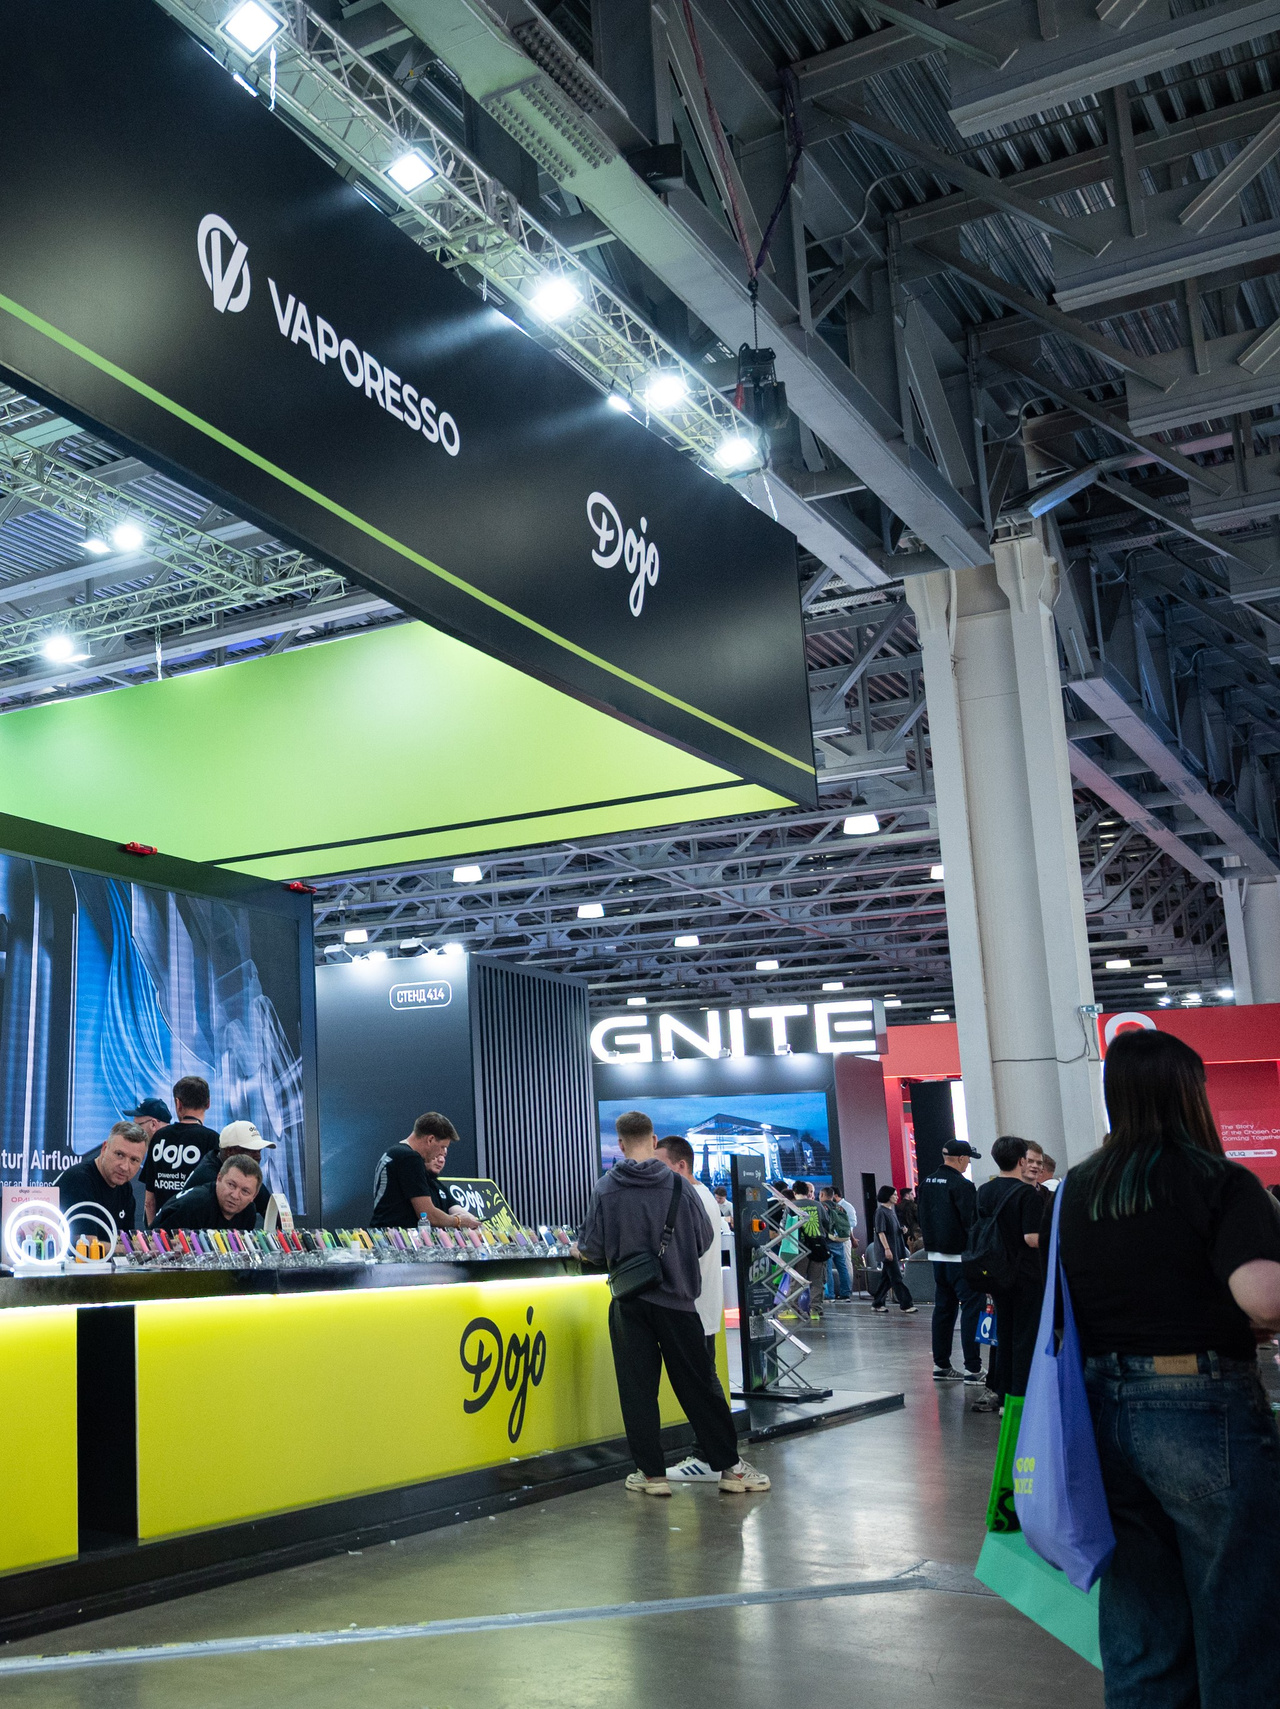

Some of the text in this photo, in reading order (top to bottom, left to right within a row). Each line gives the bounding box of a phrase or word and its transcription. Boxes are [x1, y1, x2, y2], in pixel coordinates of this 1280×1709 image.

[267, 277, 461, 457] VAPORESSO
[586, 491, 660, 617] Dojo
[396, 987, 446, 1003] СТЕНД 414
[589, 999, 878, 1065] GNITE
[152, 1138, 201, 1169] dojo
[459, 1305, 547, 1444] Dojo
